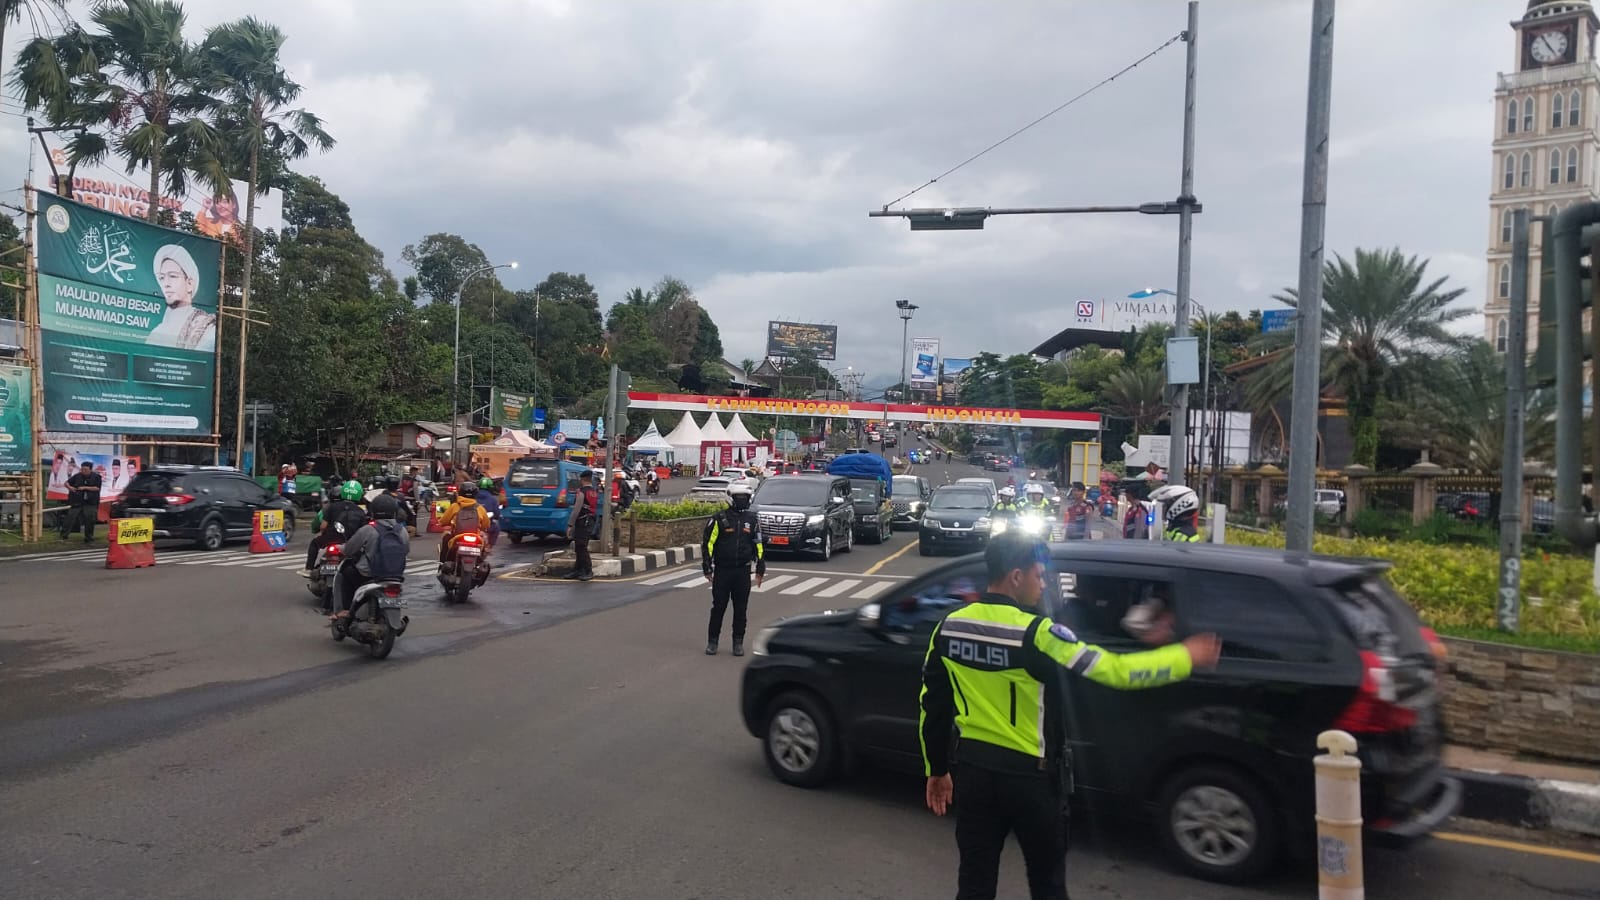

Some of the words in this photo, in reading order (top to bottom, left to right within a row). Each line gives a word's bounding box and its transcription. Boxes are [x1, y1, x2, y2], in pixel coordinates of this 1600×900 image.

[55, 283, 100, 303] MAULID
[100, 292, 127, 309] NABI
[127, 299, 161, 314] BESAR
[55, 301, 125, 325] MUHAMMAD
[126, 314, 151, 329] SAW
[1114, 301, 1168, 318] VIMALA
[707, 398, 794, 413] KABUPATEN
[796, 402, 850, 415] BOGOR
[926, 407, 1022, 423] INDONESIA
[120, 529, 149, 539] POWER
[948, 639, 1010, 667] POLISI
